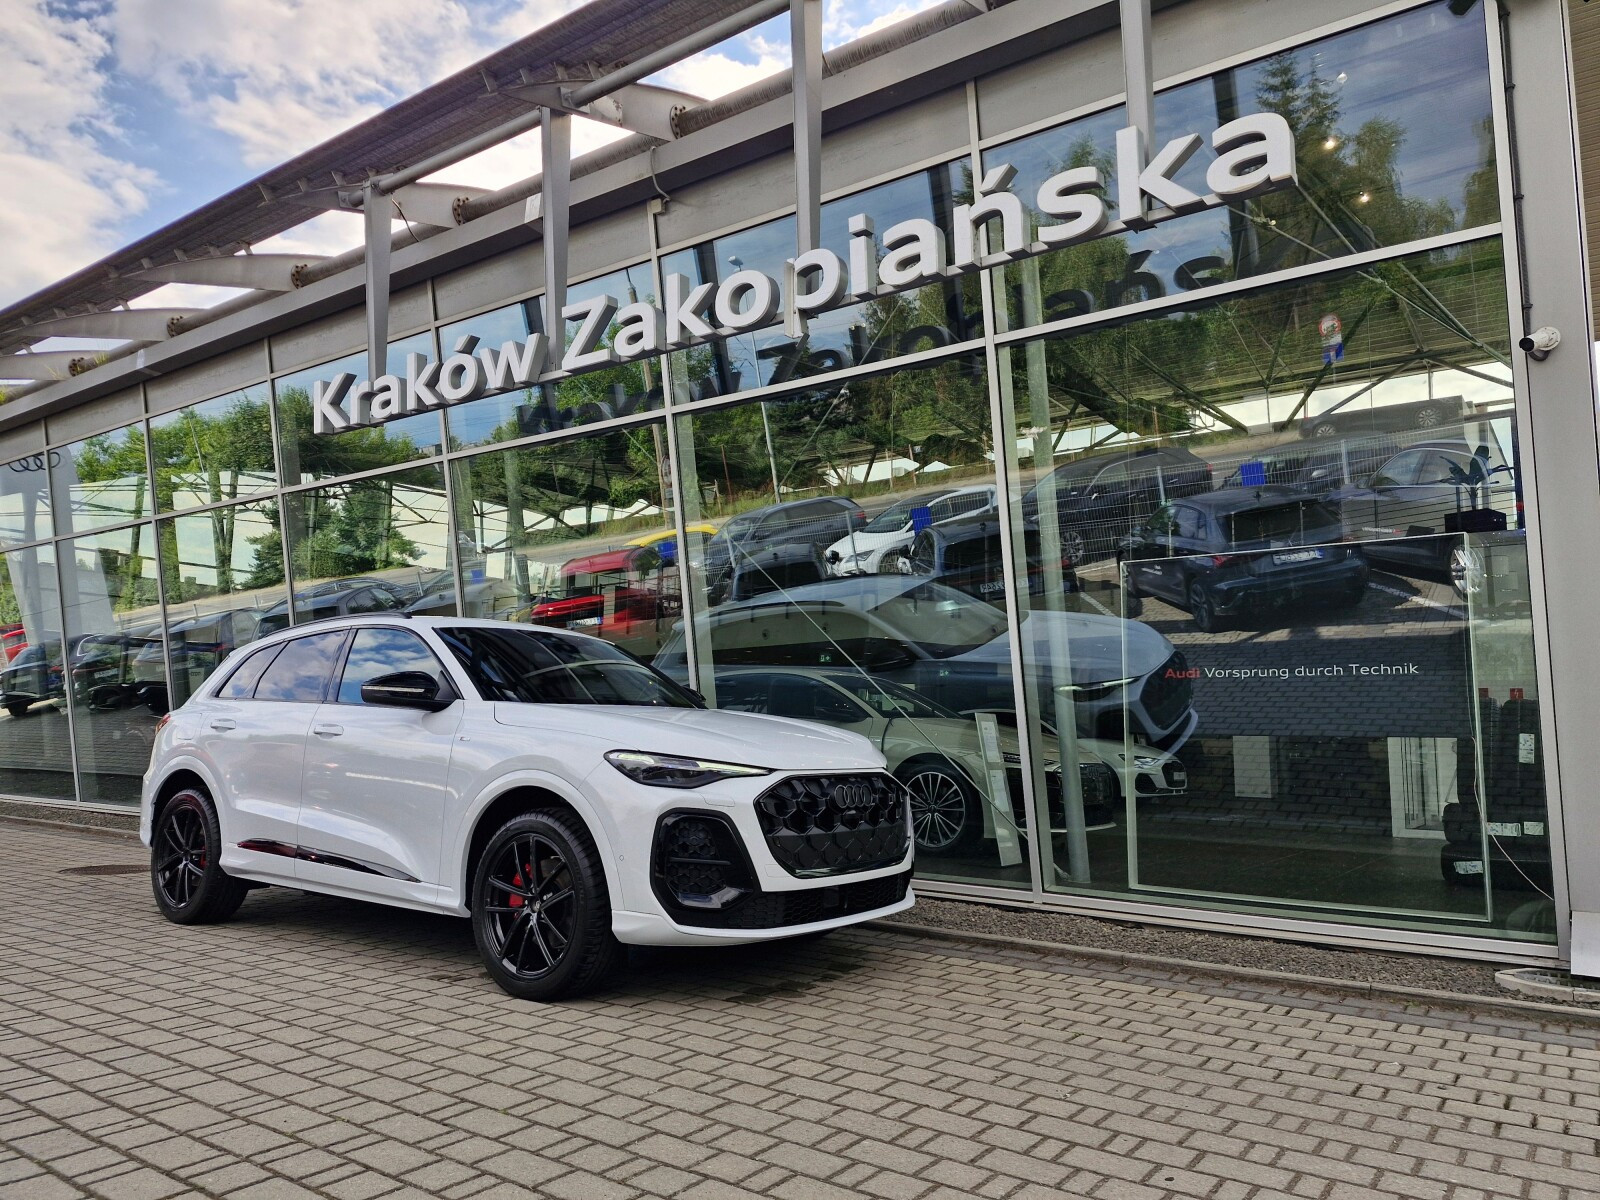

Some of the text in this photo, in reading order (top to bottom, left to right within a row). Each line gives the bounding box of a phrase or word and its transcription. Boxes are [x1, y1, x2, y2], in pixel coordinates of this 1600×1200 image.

[314, 333, 549, 435] Kraków
[562, 112, 1297, 372] Zakopiańska
[1165, 663, 1419, 680] Audi Vorsprung durch Technik
